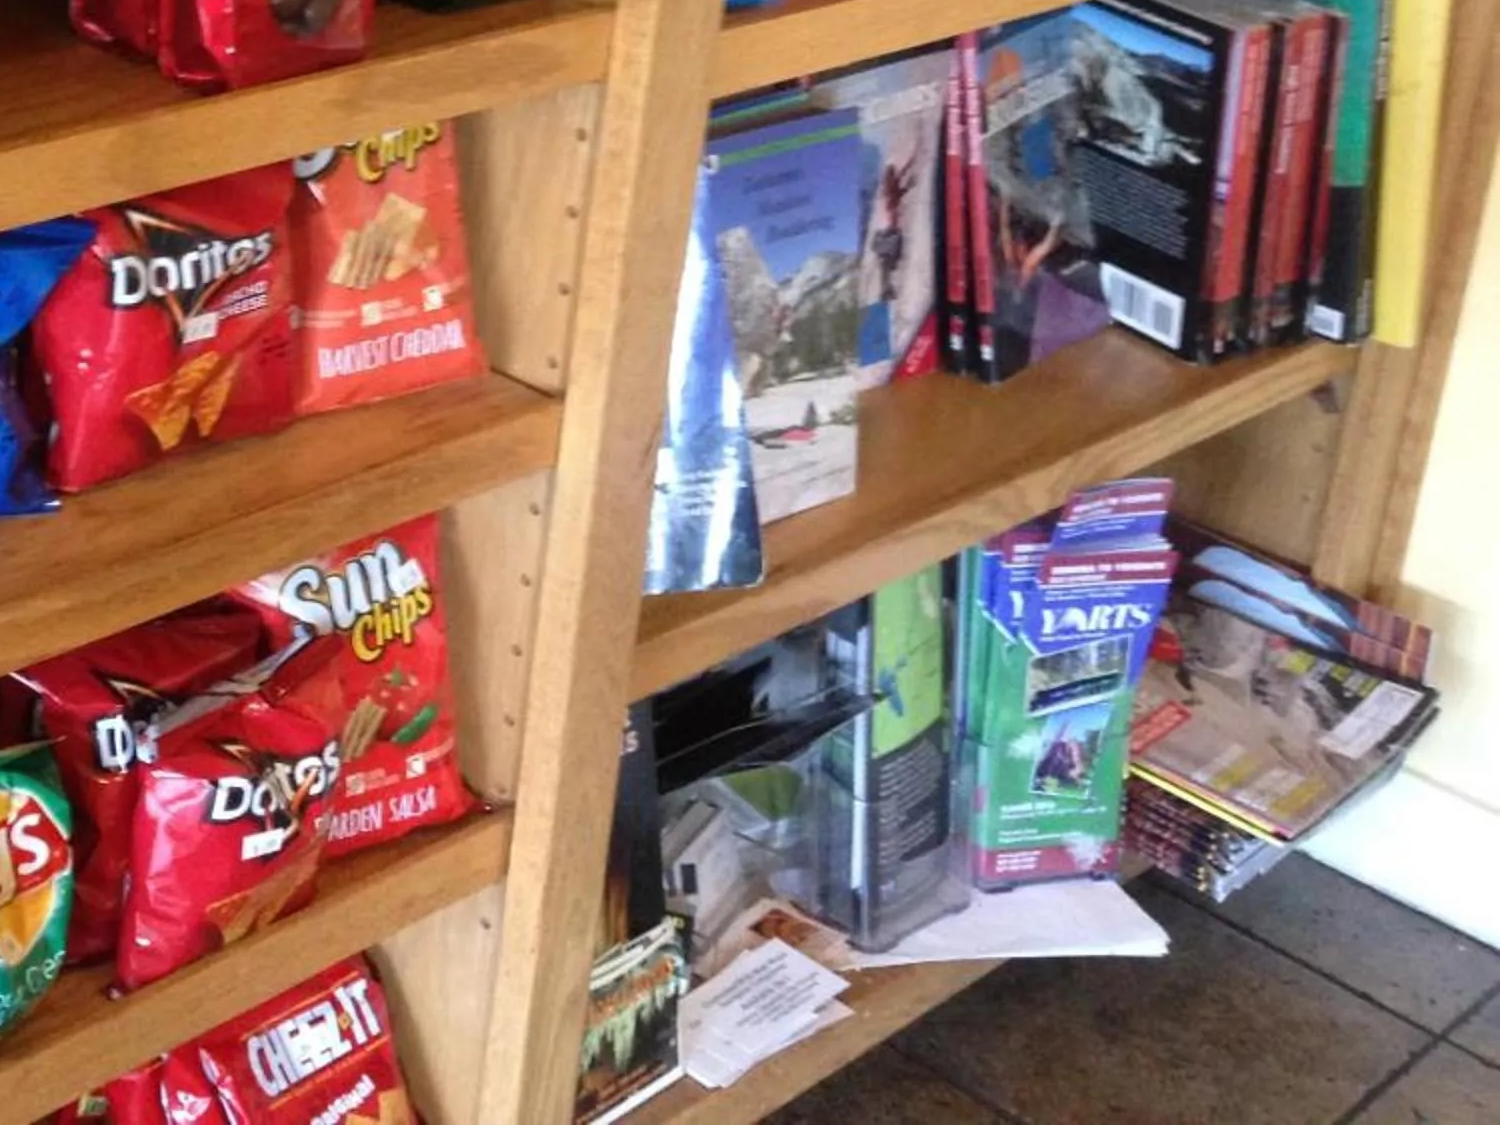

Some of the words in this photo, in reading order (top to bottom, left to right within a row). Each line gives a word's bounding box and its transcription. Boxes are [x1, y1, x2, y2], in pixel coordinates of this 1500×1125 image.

[110, 231, 274, 306] Doritos
[279, 539, 406, 639] Sun
[352, 586, 434, 663] Chips
[1041, 602, 1152, 635] YARTS
